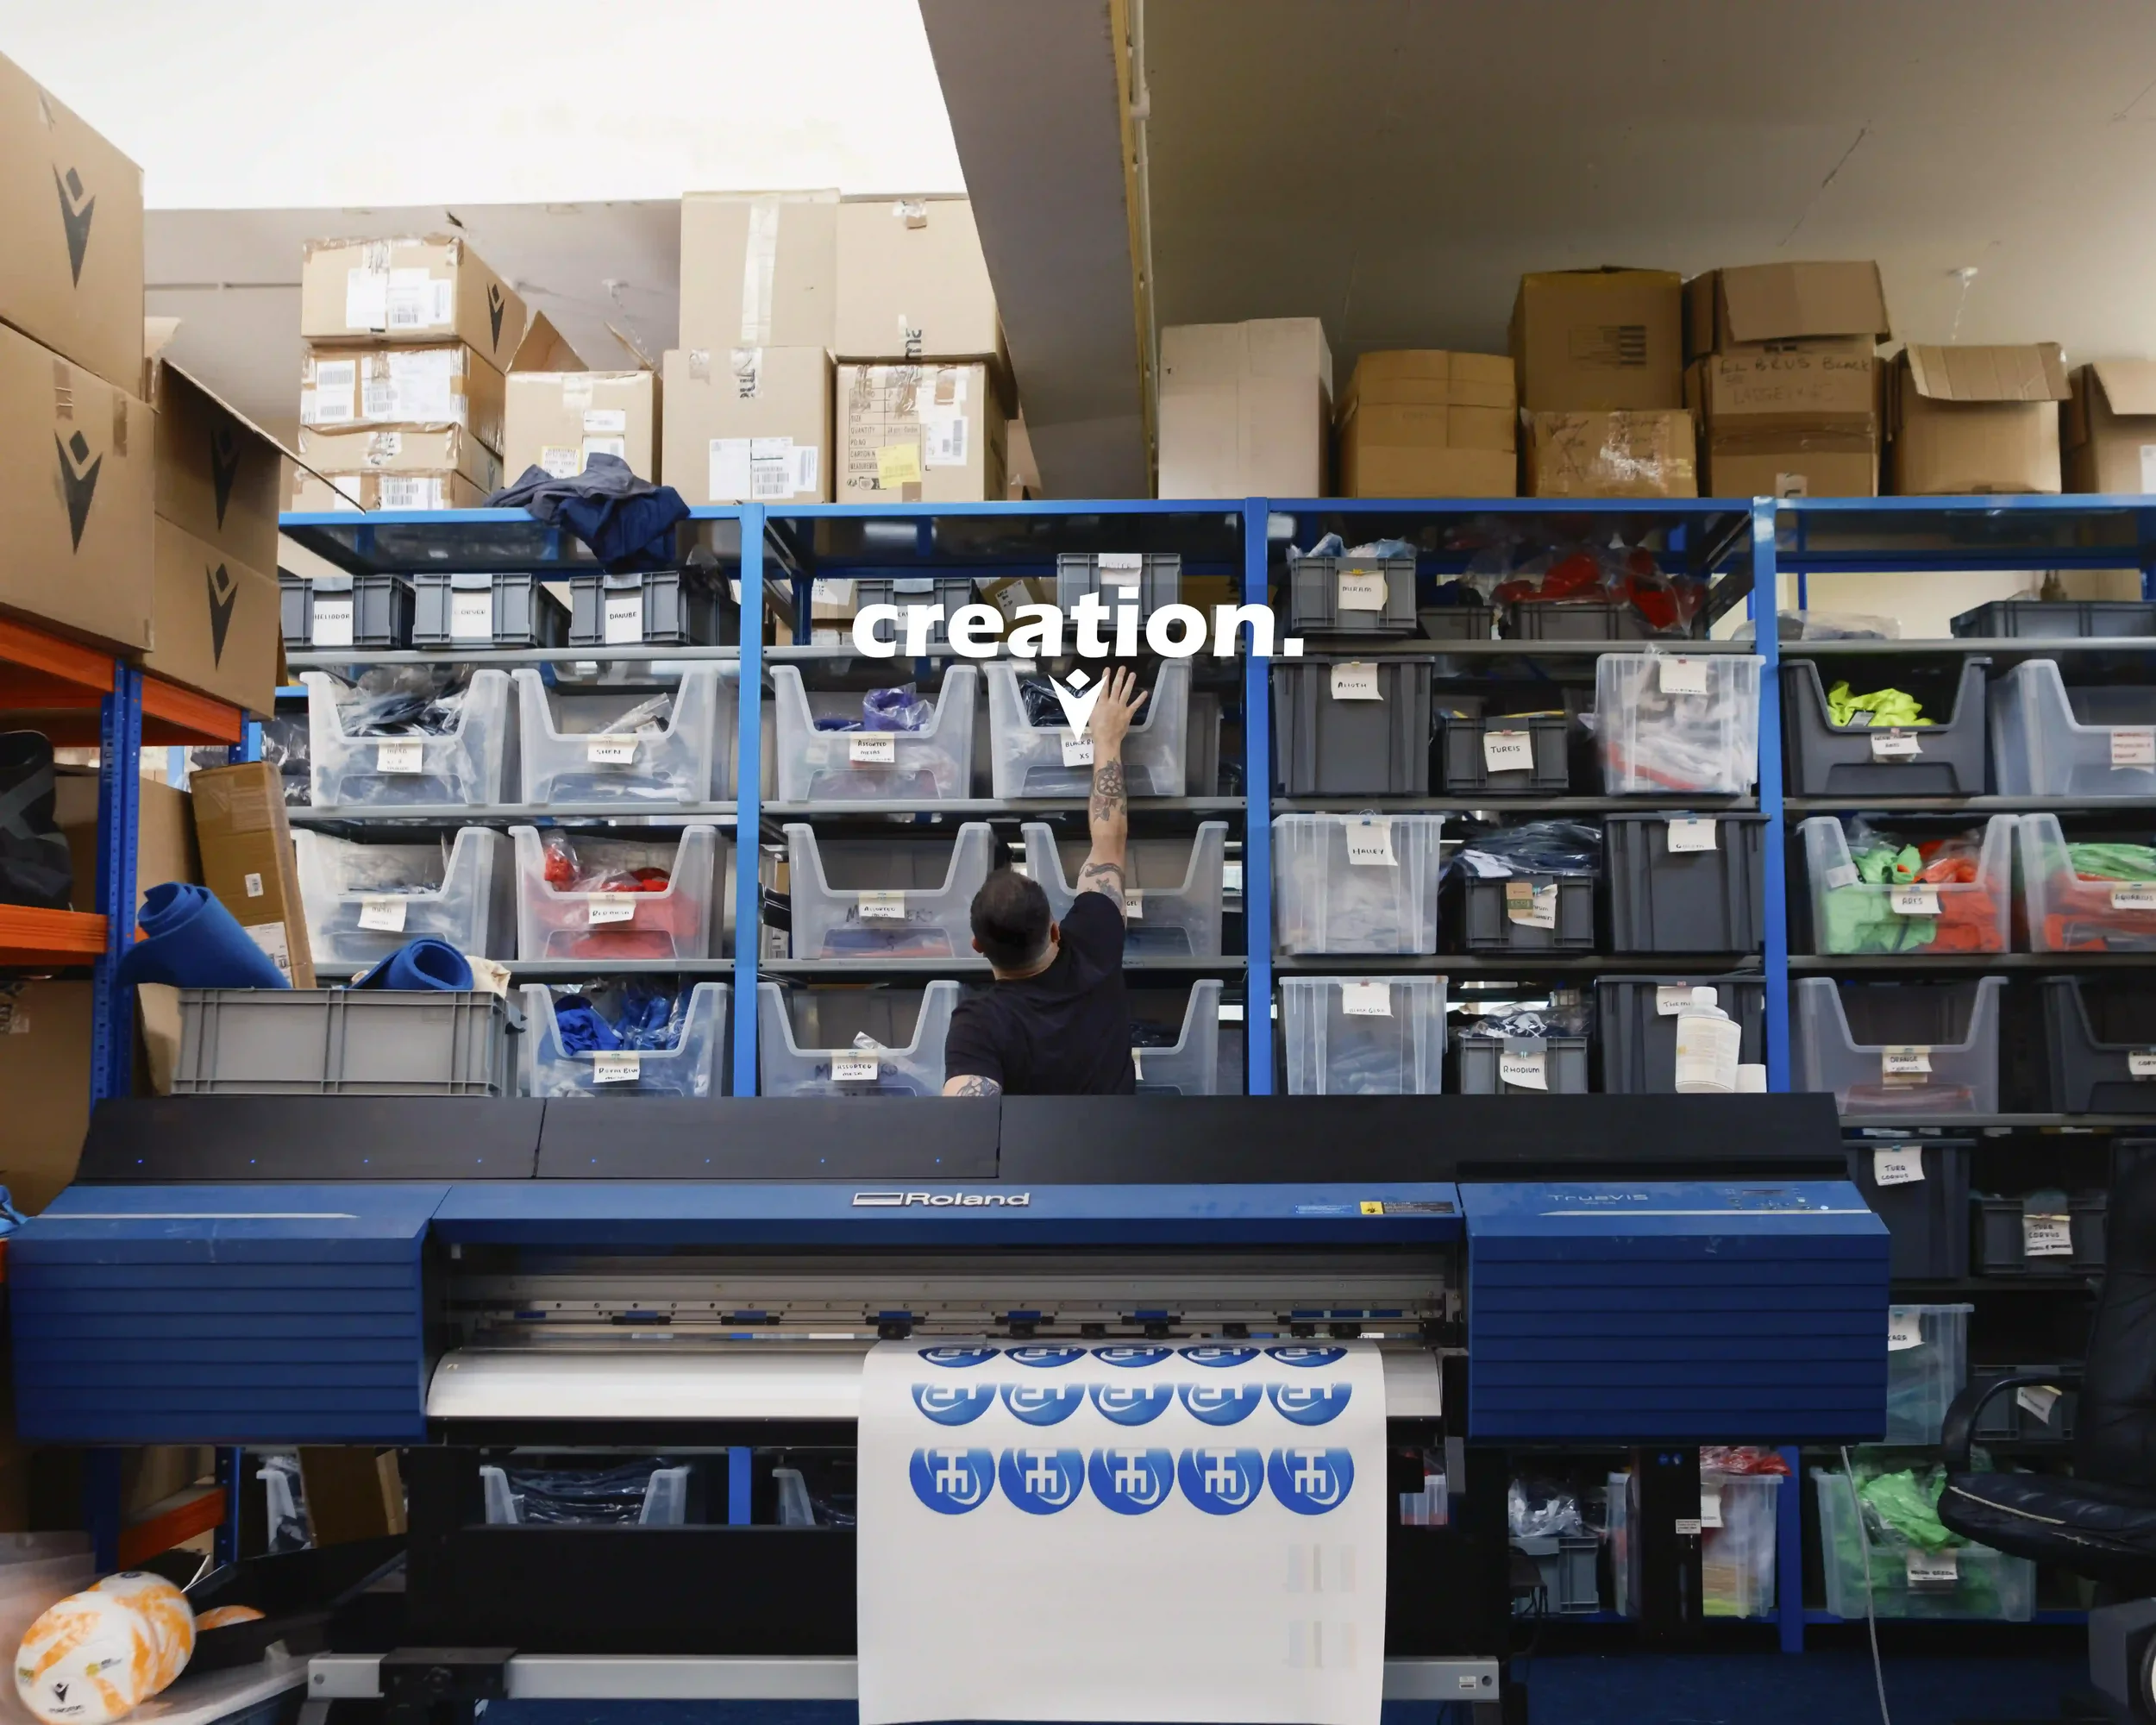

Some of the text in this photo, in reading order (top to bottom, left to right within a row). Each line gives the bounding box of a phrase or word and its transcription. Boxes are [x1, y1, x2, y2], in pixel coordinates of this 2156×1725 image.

[609, 612, 637, 620] DANUBE
[1490, 745, 1521, 754] TUREIS
[1503, 1065, 1540, 1074] RHODIUM
[905, 1192, 1030, 1207] Roland
